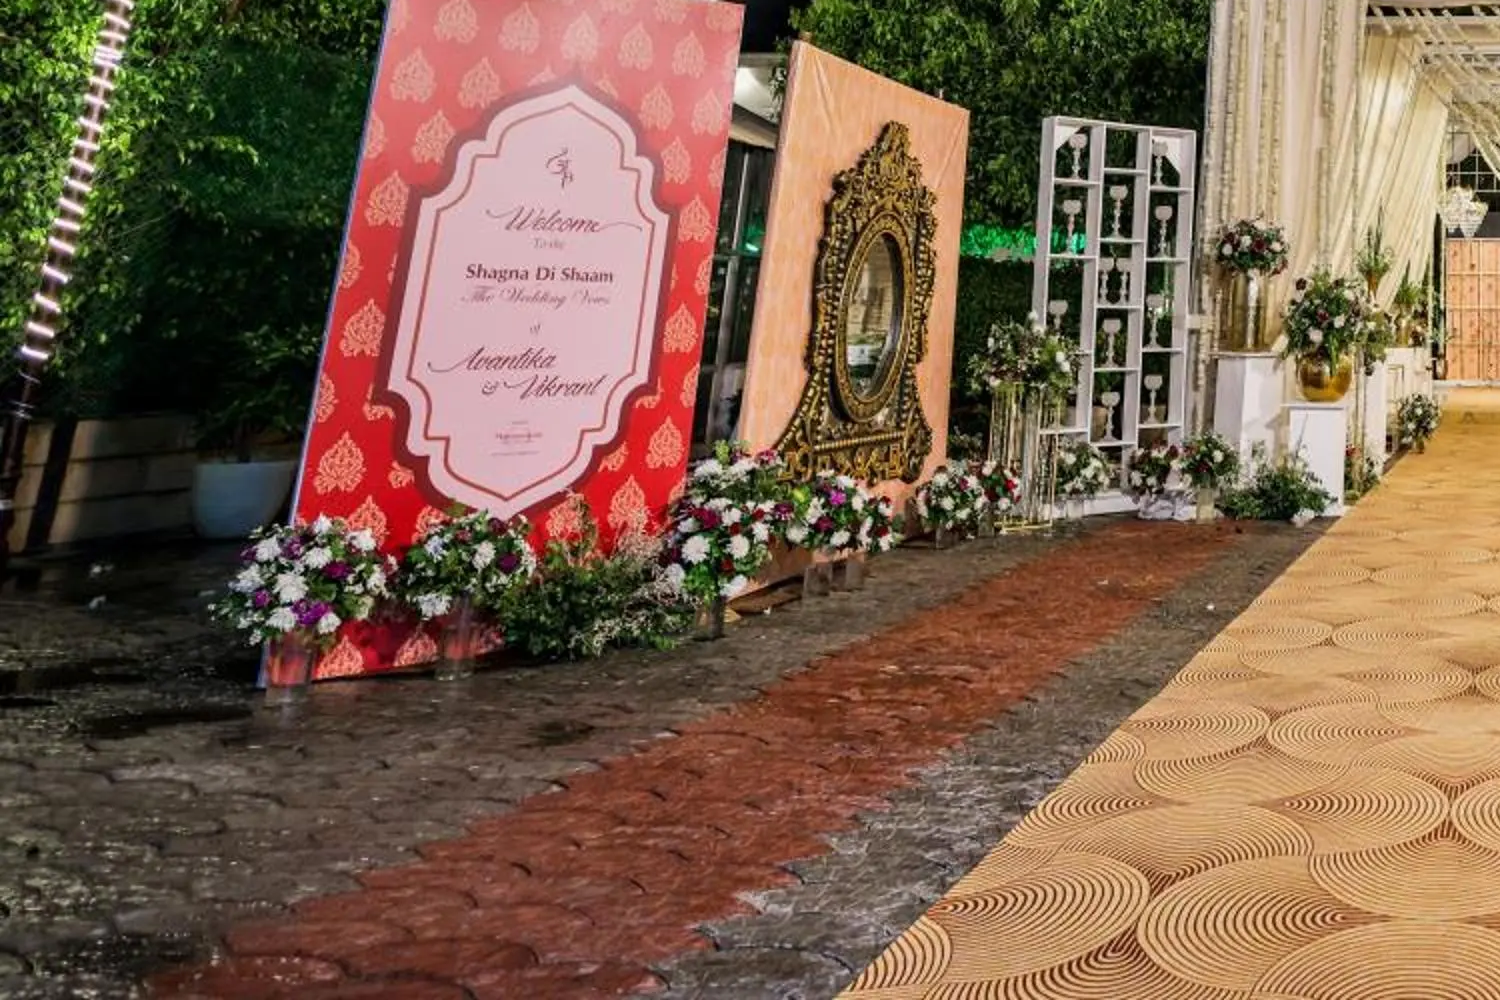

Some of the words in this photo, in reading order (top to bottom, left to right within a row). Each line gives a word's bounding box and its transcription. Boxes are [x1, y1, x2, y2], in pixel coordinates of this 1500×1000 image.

[485, 206, 643, 233] Welcome
[465, 263, 529, 283] Shagna
[535, 266, 555, 281] Di
[560, 267, 614, 283] Shaam
[428, 347, 557, 372] Avantika
[503, 374, 609, 400] Vikrant
